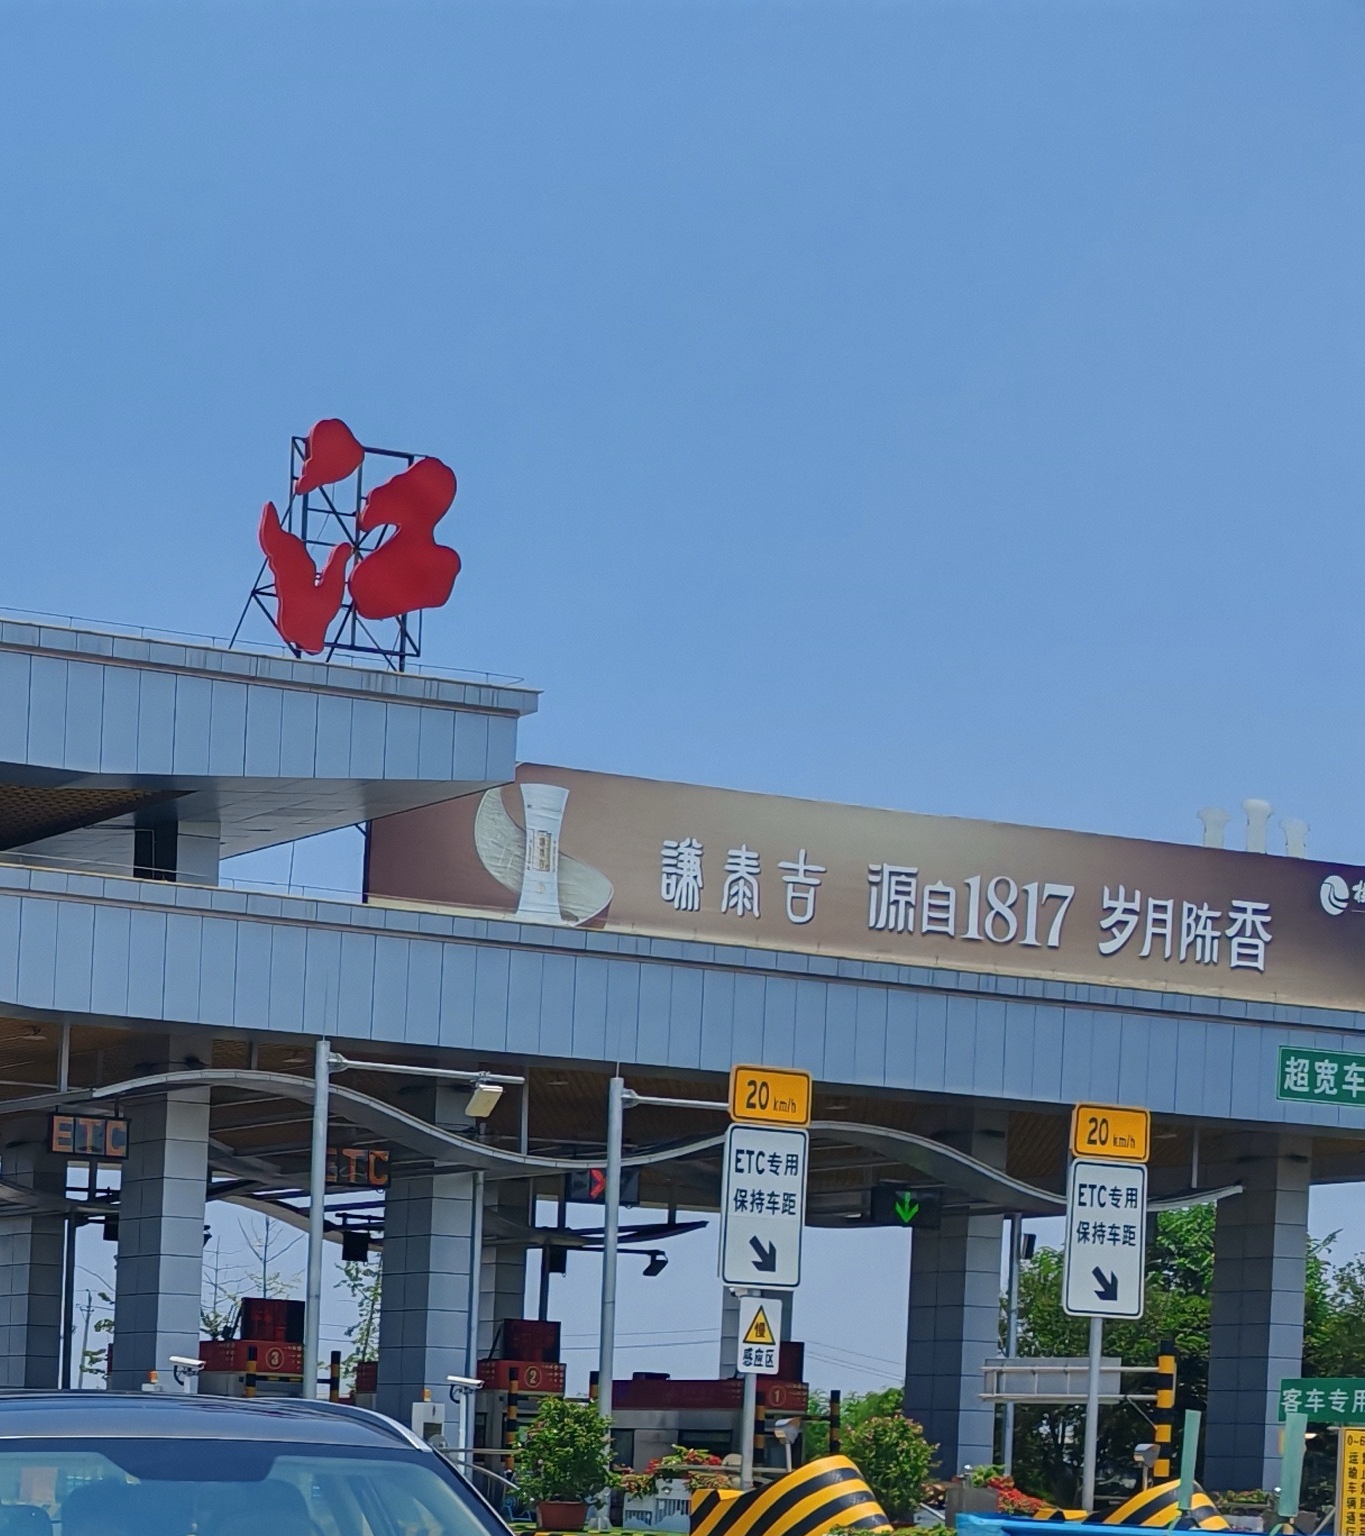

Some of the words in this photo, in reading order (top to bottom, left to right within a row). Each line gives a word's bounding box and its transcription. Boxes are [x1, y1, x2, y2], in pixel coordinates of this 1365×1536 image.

[868, 863, 1075, 948] 源自1817
[1098, 884, 1273, 972] 岁月陈香
[746, 1079, 769, 1110] 20
[773, 1097, 797, 1113] km/h
[52, 1115, 127, 1157] ETC
[1087, 1117, 1109, 1146] 20
[1113, 1134, 1135, 1149] km/h
[734, 1148, 799, 1176] ETC专用
[733, 1188, 797, 1215] 保持车距
[1078, 1183, 1138, 1209] ETC专用
[1076, 1220, 1136, 1247] 保持车距
[270, 1350, 279, 1365] 3
[743, 1347, 775, 1368] 感应区
[529, 1369, 538, 1384] 2
